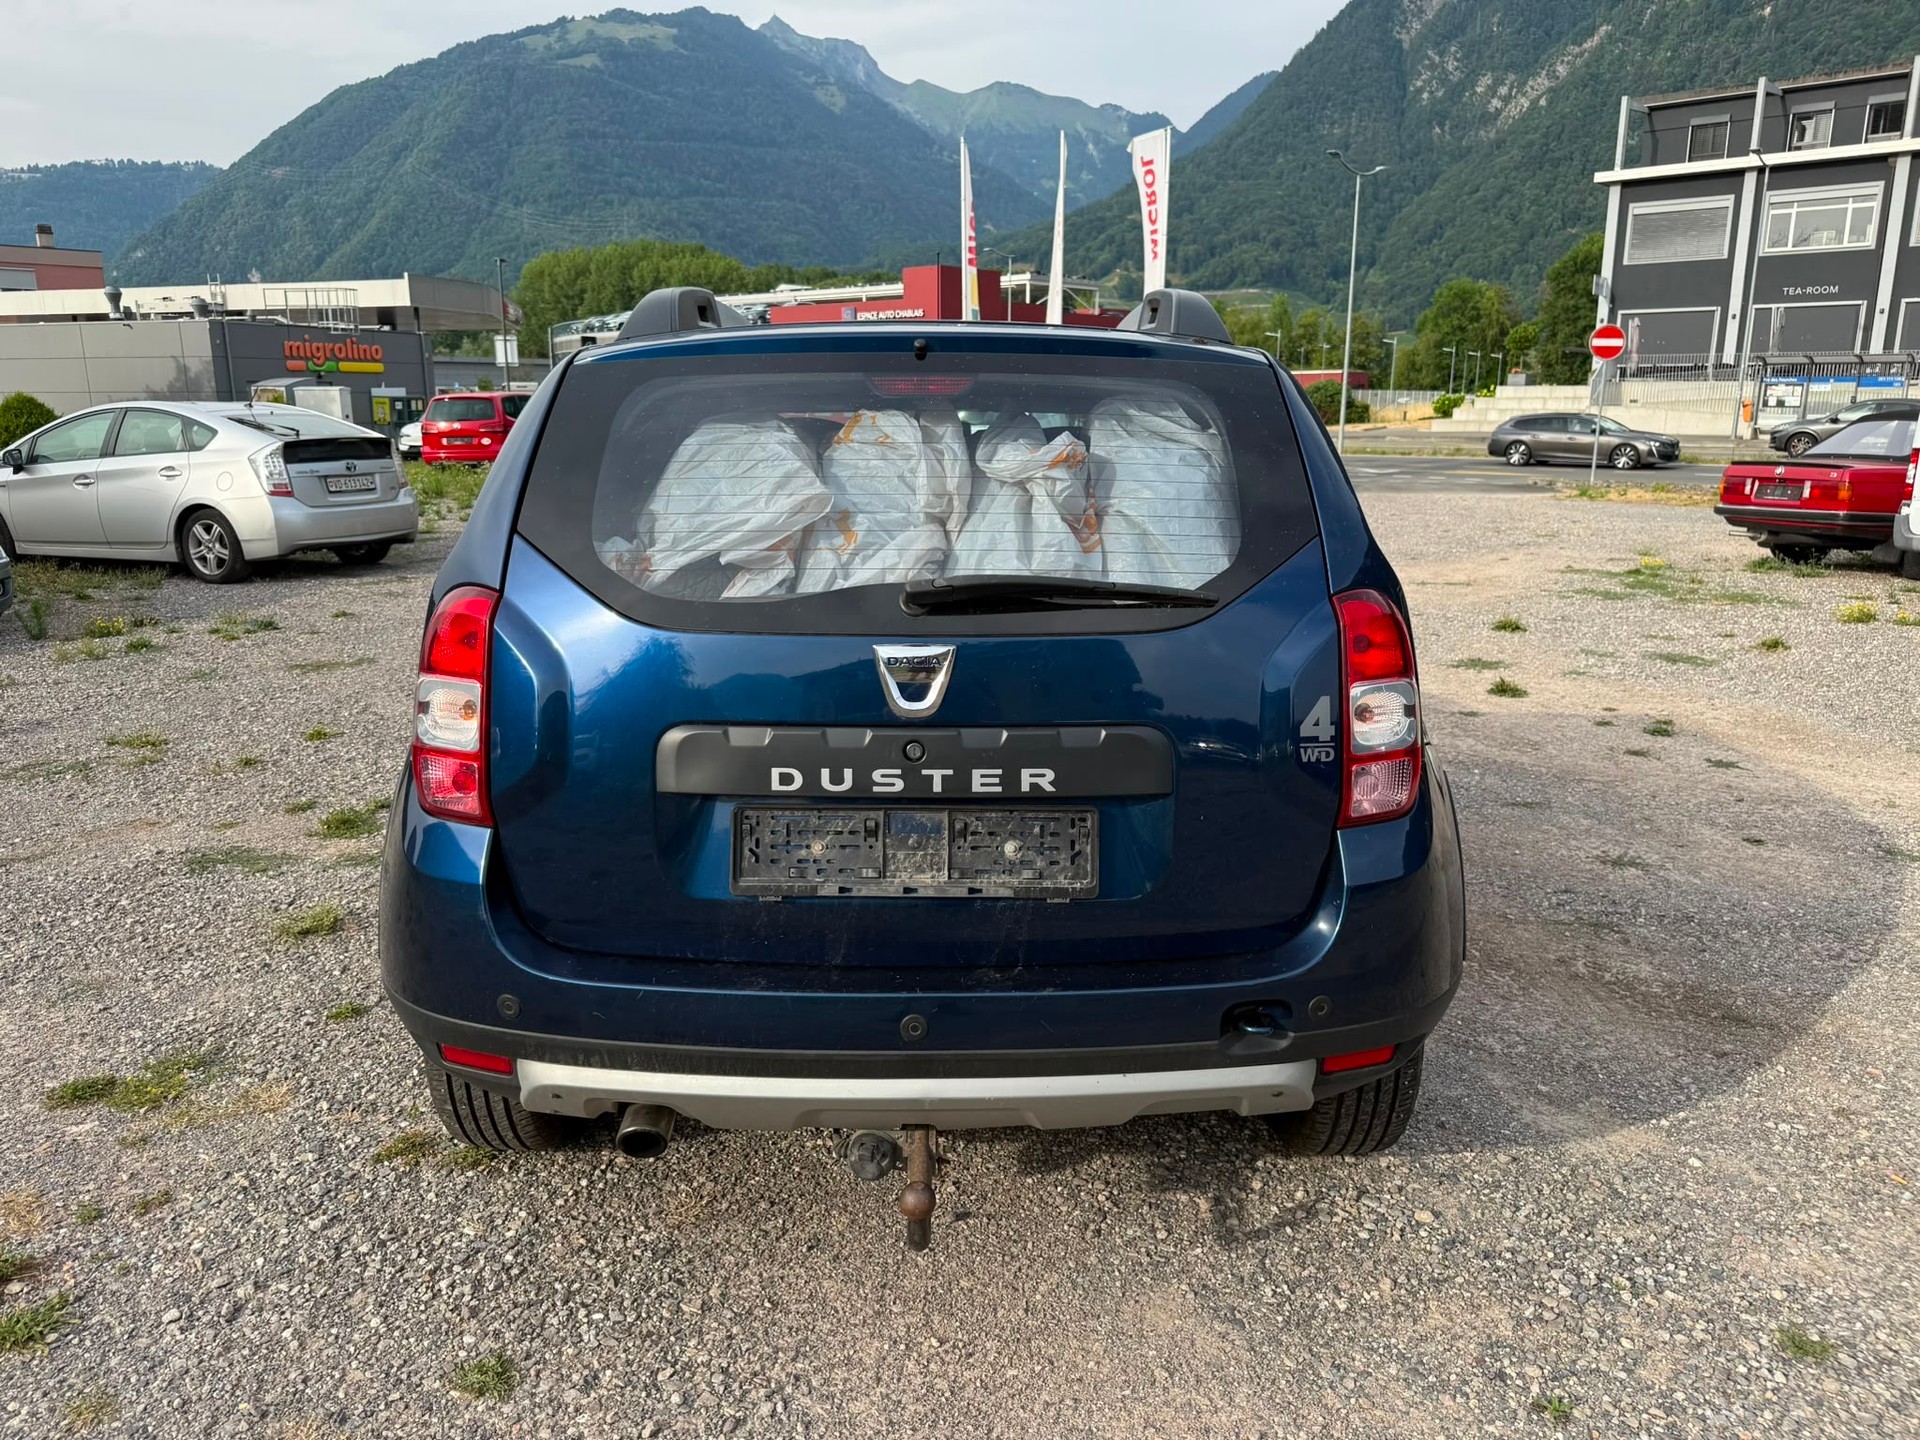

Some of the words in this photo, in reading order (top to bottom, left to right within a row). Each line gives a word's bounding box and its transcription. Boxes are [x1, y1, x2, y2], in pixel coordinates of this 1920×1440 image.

[1782, 285, 1839, 296] TEA-ROOM
[857, 311, 878, 320] ESPACE
[879, 309, 895, 319] AUTO
[896, 308, 925, 318] CHABLAIS
[284, 334, 383, 366] migrolino
[887, 656, 941, 668] DACIA
[1299, 695, 1336, 742] 4
[1300, 747, 1335, 763] WD
[770, 767, 1057, 793] DUSTER
